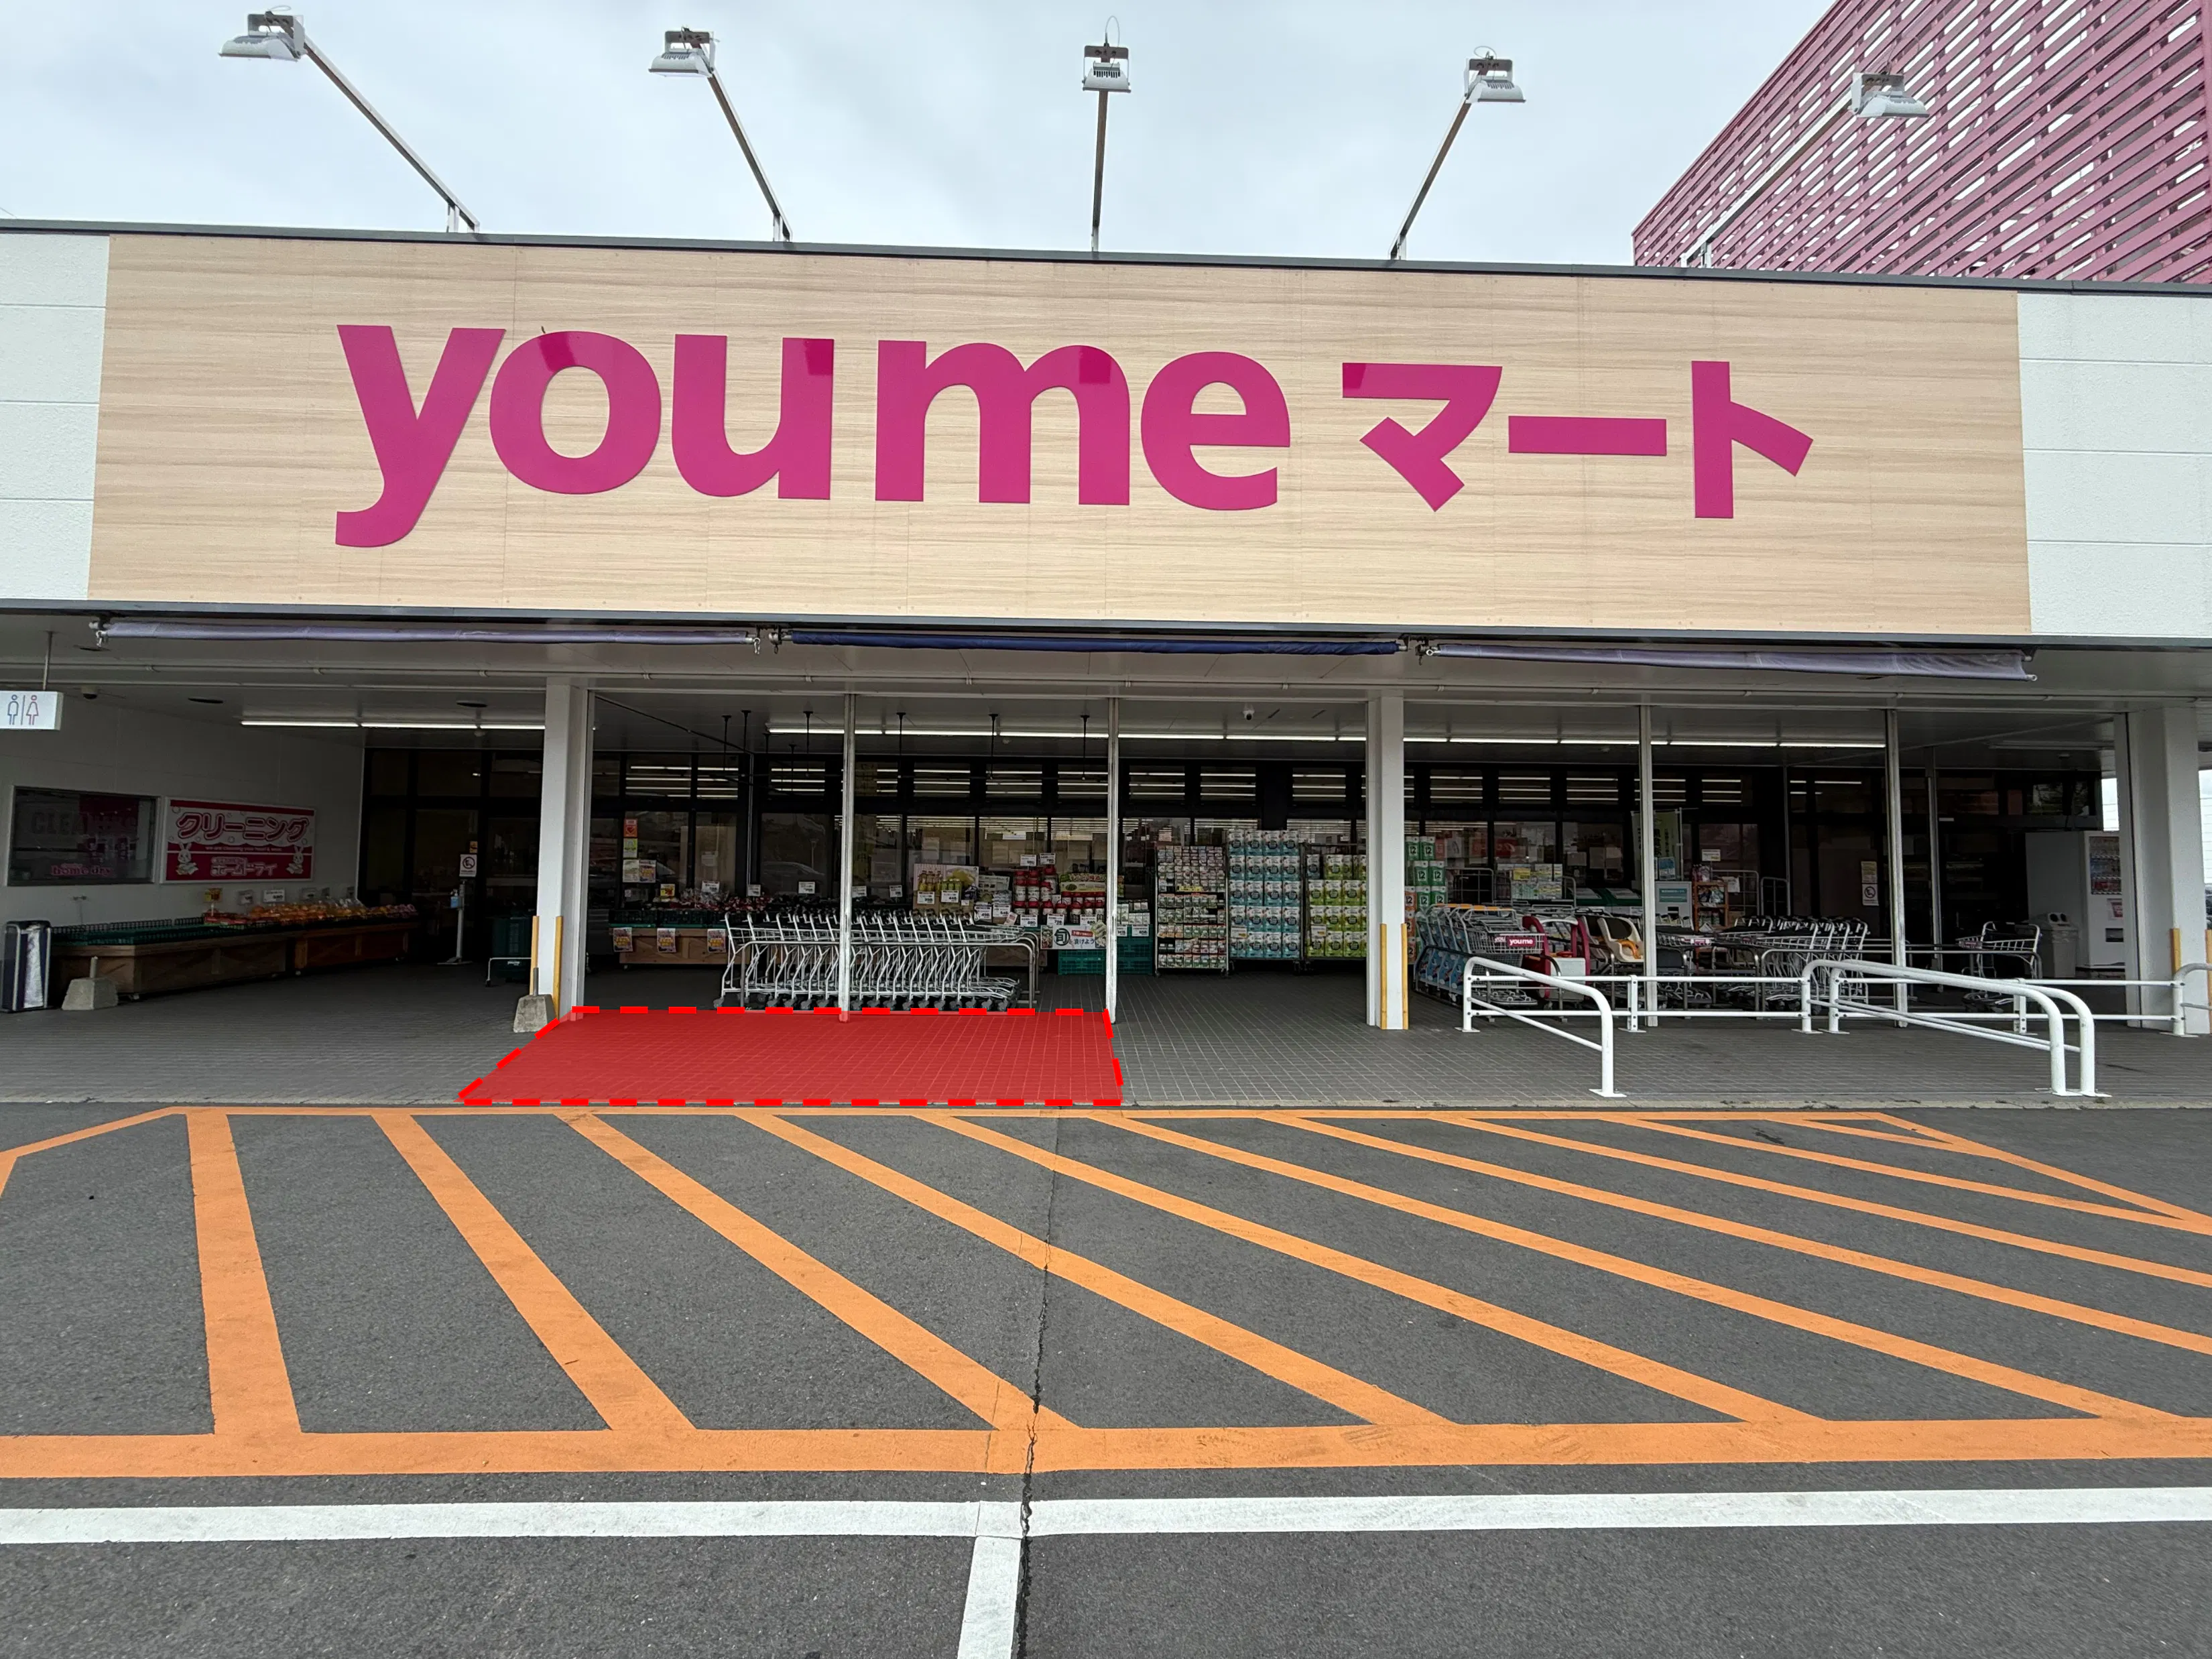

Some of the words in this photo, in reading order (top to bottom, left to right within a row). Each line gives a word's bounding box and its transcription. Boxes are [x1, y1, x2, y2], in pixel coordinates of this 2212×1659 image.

[336, 325, 1291, 548] youme
[1343, 361, 1813, 518] マート
[177, 812, 309, 842] クリーニング
[1410, 846, 1416, 854] 12
[1425, 847, 1432, 855] 12
[210, 863, 278, 877] ホームドライ
[1436, 896, 1443, 904] 12
